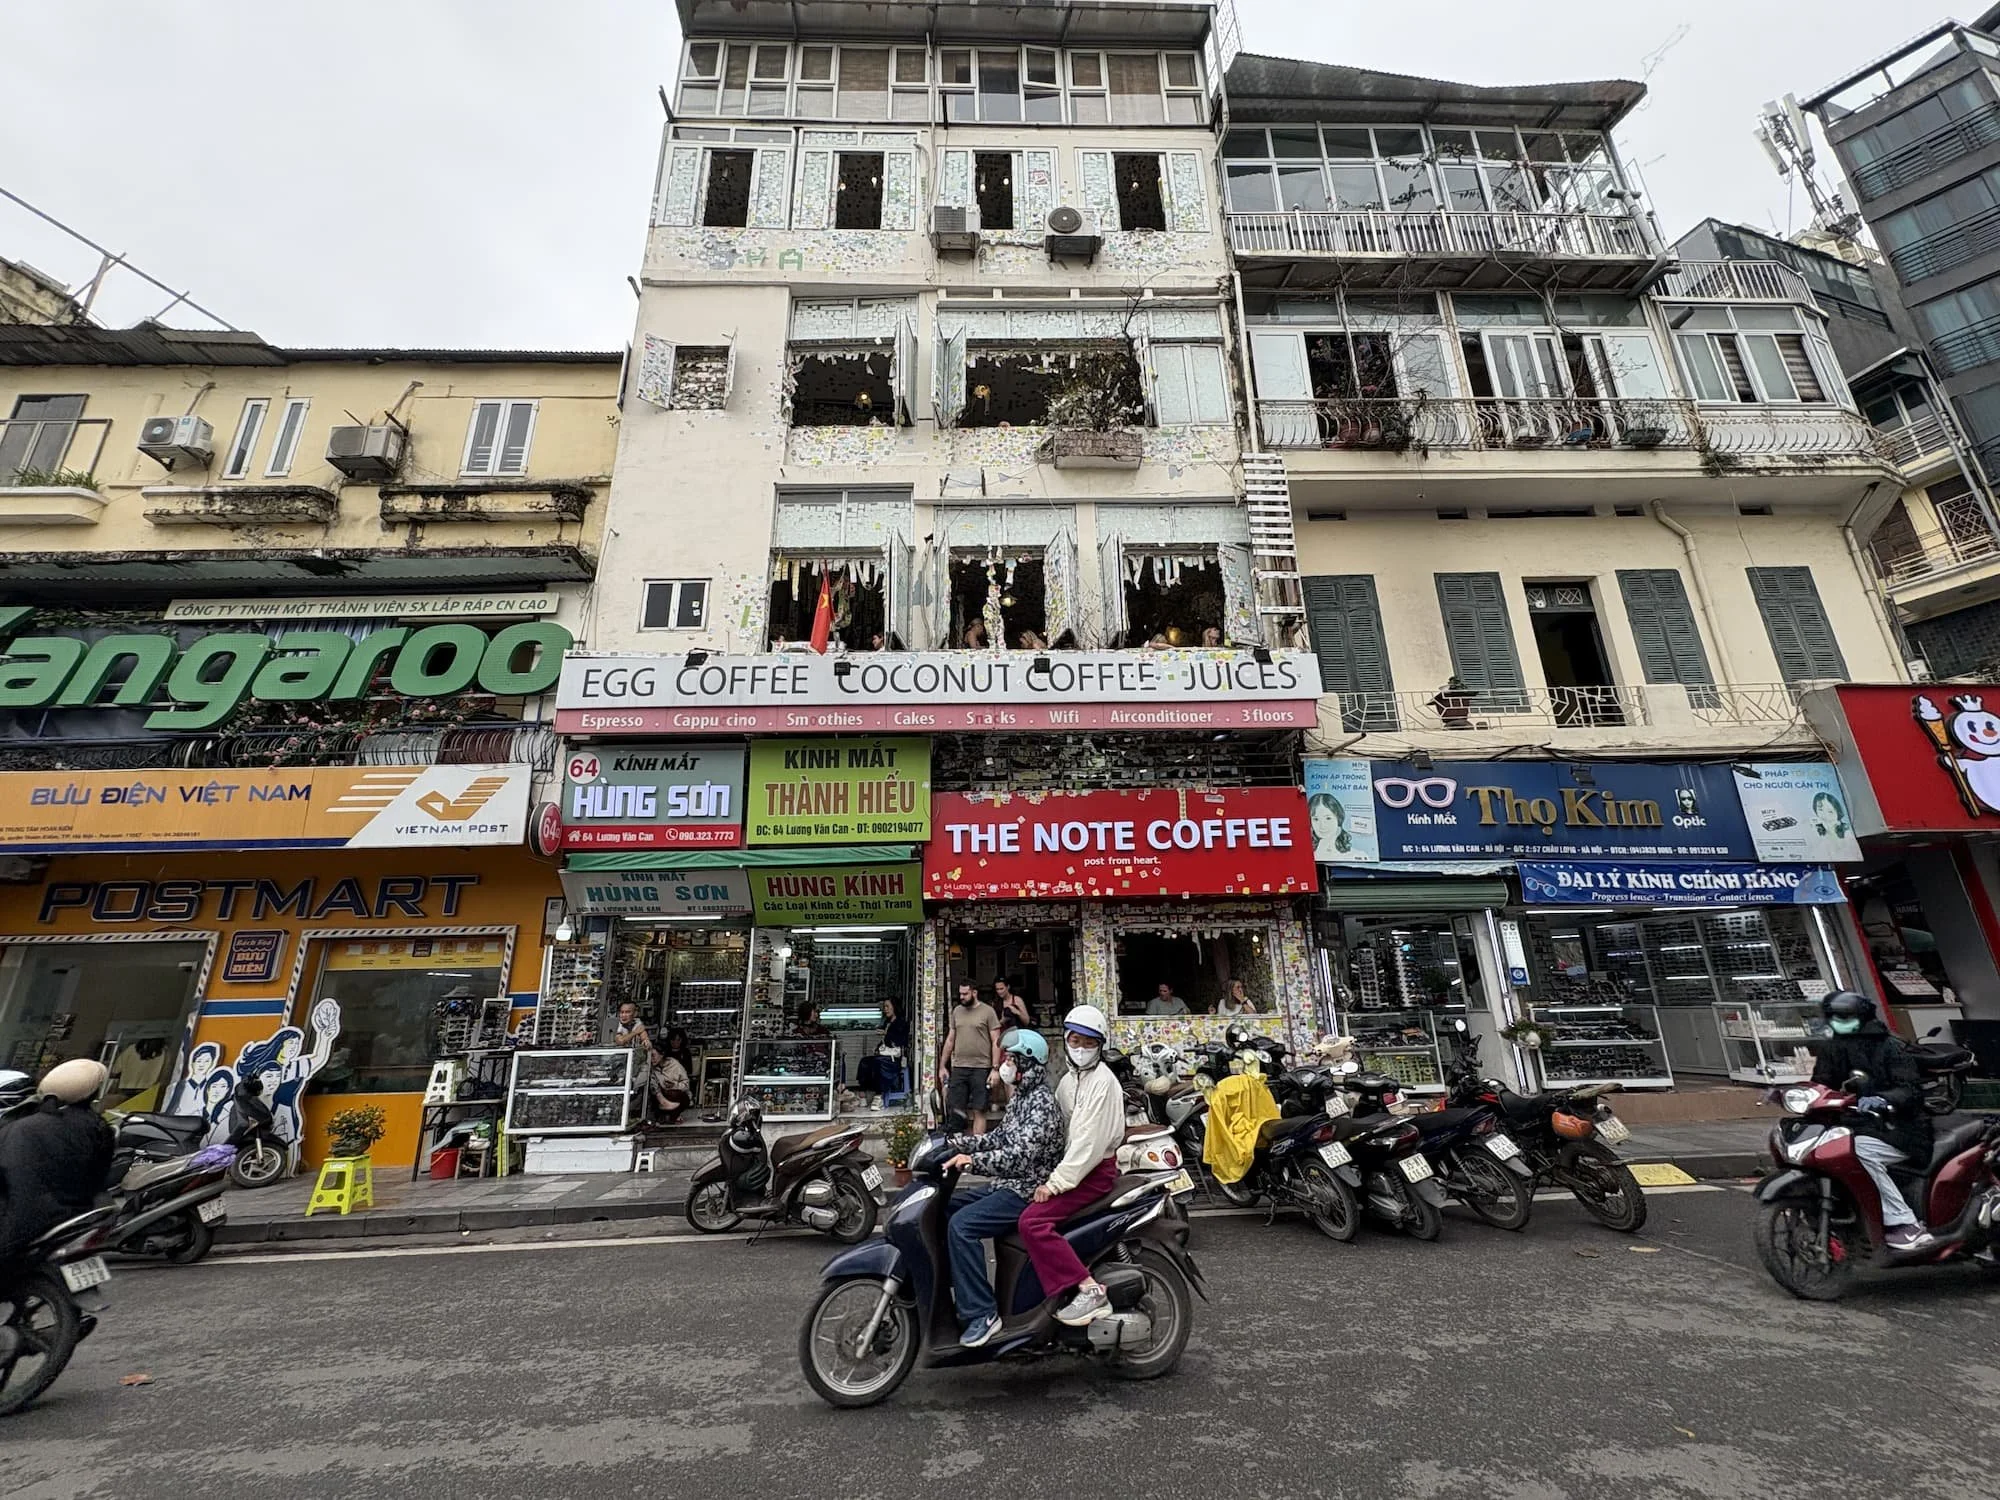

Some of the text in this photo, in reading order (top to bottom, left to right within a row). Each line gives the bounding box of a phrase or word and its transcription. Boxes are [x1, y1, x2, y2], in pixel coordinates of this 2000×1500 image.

[174, 602, 215, 616] CÔNG
[218, 604, 239, 616] TY
[239, 604, 279, 615] TNHH
[283, 602, 317, 615] MỘT
[320, 601, 368, 614] THÀNH
[373, 600, 406, 613] VIÊN
[409, 601, 427, 612] SX
[463, 599, 493, 611] RÁP
[496, 599, 516, 610] CN
[519, 599, 548, 610] CAO
[0, 607, 574, 730] angaroo
[582, 661, 1297, 698] EGG COFFEE COCONUT COFFEE JUICES
[581, 713, 643, 729] Espresso
[894, 711, 935, 725] Cakes
[1049, 709, 1080, 723] Wifi
[1110, 708, 1213, 723] Airconditioner
[613, 752, 700, 771] KÍNH MẮT
[784, 741, 897, 770] KÍNH MẮT
[570, 758, 598, 778] 64
[30, 780, 312, 807] BƯU ĐIỆN VIỆT NAM
[573, 777, 730, 818] HÙNG SƠN
[765, 769, 916, 816] THÀNH HIẾU
[1407, 811, 1457, 825] Kính Mắt
[1465, 785, 1664, 836] Thọ Kim
[396, 823, 509, 836] VIETNAM POST
[756, 825, 771, 836] ĐC:
[773, 824, 784, 836] 64
[786, 823, 812, 837] Lương
[814, 823, 831, 835] Văn
[832, 823, 849, 834] Can
[1672, 815, 1706, 829] Optic
[582, 832, 593, 842] 64
[622, 831, 636, 842] Văn
[638, 831, 654, 841] Can
[945, 817, 1293, 854] THE NOTE COFFEE
[1084, 856, 1162, 867] post from heart.
[767, 870, 904, 897] HÙNG KÍNH
[1557, 871, 1594, 890] ĐẠI
[1597, 868, 1621, 889] LÝ
[1625, 868, 1674, 889] KÍNH
[1679, 869, 1736, 890] CHÍNH
[38, 875, 480, 923] POSTMART
[585, 882, 729, 902] HÙNG SƠN
[1592, 892, 1774, 903] Progress lenses Transition Contact lenses
[763, 900, 783, 911] Các
[883, 898, 913, 910] Trang
